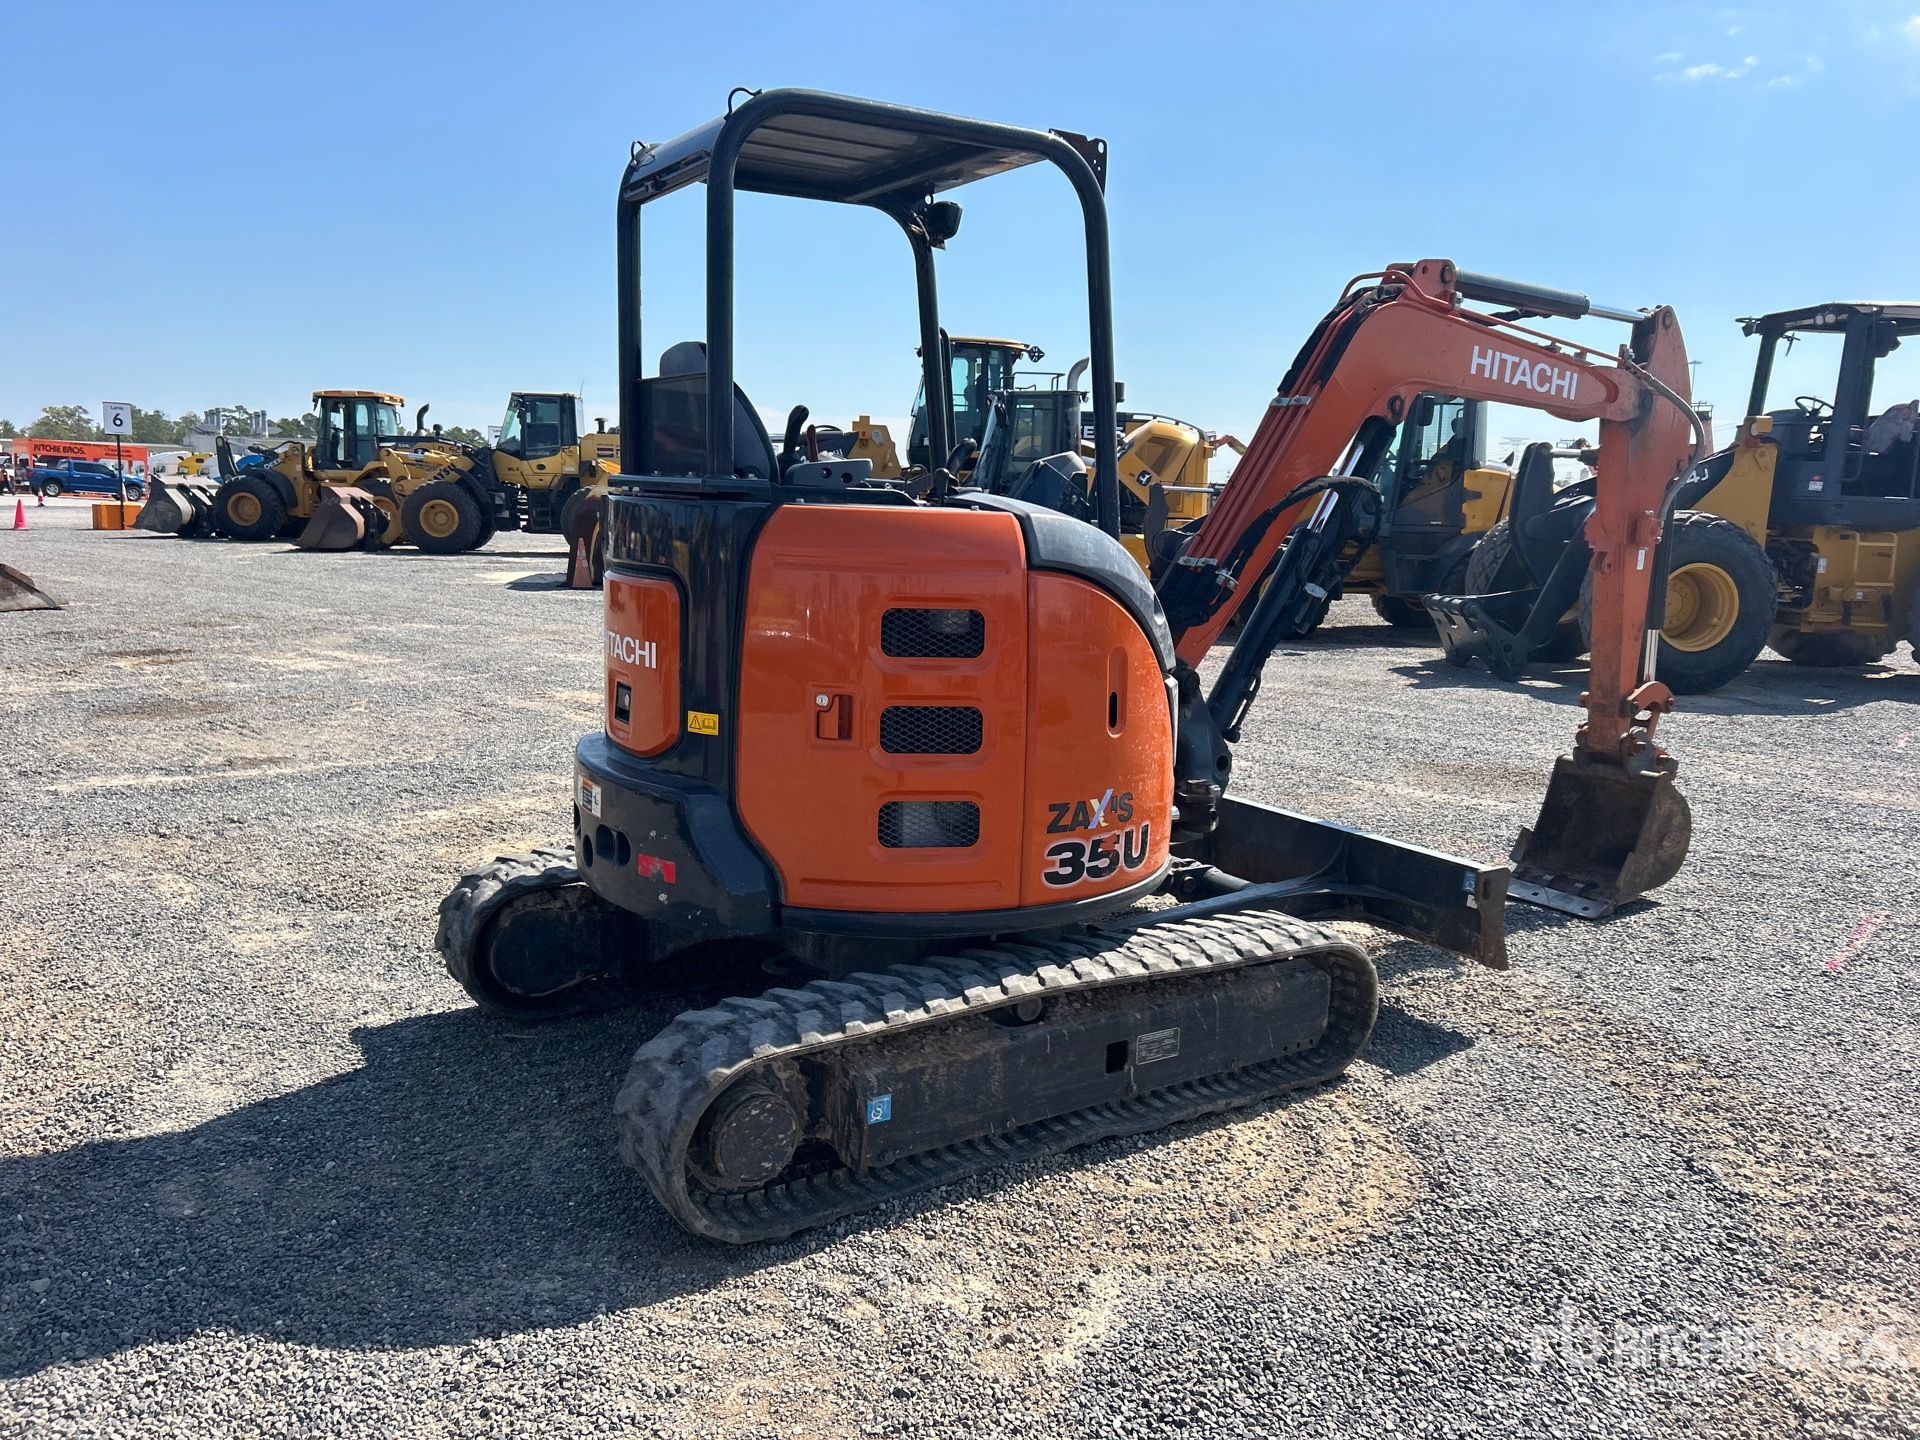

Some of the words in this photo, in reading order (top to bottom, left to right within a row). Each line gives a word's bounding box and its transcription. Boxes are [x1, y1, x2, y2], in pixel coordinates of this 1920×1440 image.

[1470, 345, 1578, 401] HITACHI
[112, 413, 124, 428] 6
[33, 444, 61, 453] RITCHIE
[1043, 822, 1151, 887] 35U
